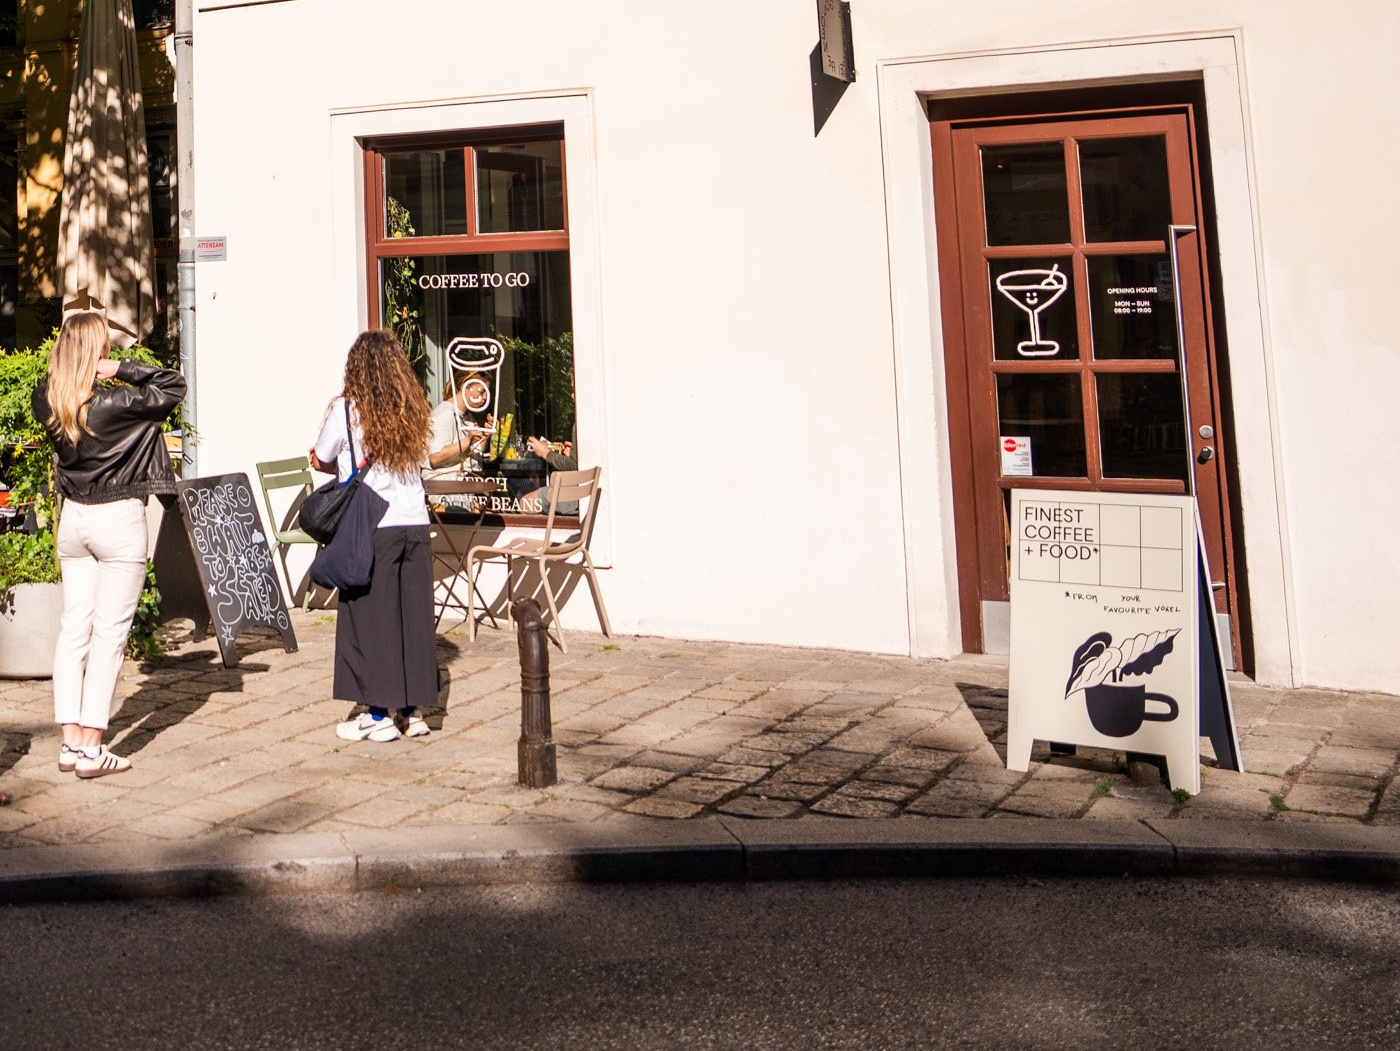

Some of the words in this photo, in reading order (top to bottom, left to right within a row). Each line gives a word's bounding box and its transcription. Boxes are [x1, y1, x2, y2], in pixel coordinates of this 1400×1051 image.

[197, 241, 224, 249] ATTENSAM
[418, 274, 479, 290] COFFEE
[480, 272, 503, 288] TO
[504, 271, 531, 288] GO
[1106, 287, 1135, 295] OPENING
[1135, 286, 1158, 294] HOURS
[182, 483, 238, 526] PLEASE
[490, 497, 543, 512] BEANS
[1025, 506, 1084, 524] FINEST
[206, 512, 255, 557] WAIT
[1024, 524, 1094, 543] COFFEE
[202, 554, 226, 581] TO
[244, 544, 265, 576] BE
[217, 564, 280, 625] SEATED
[1120, 594, 1141, 602] YOUR
[1103, 605, 1151, 615] FAVOURITE
